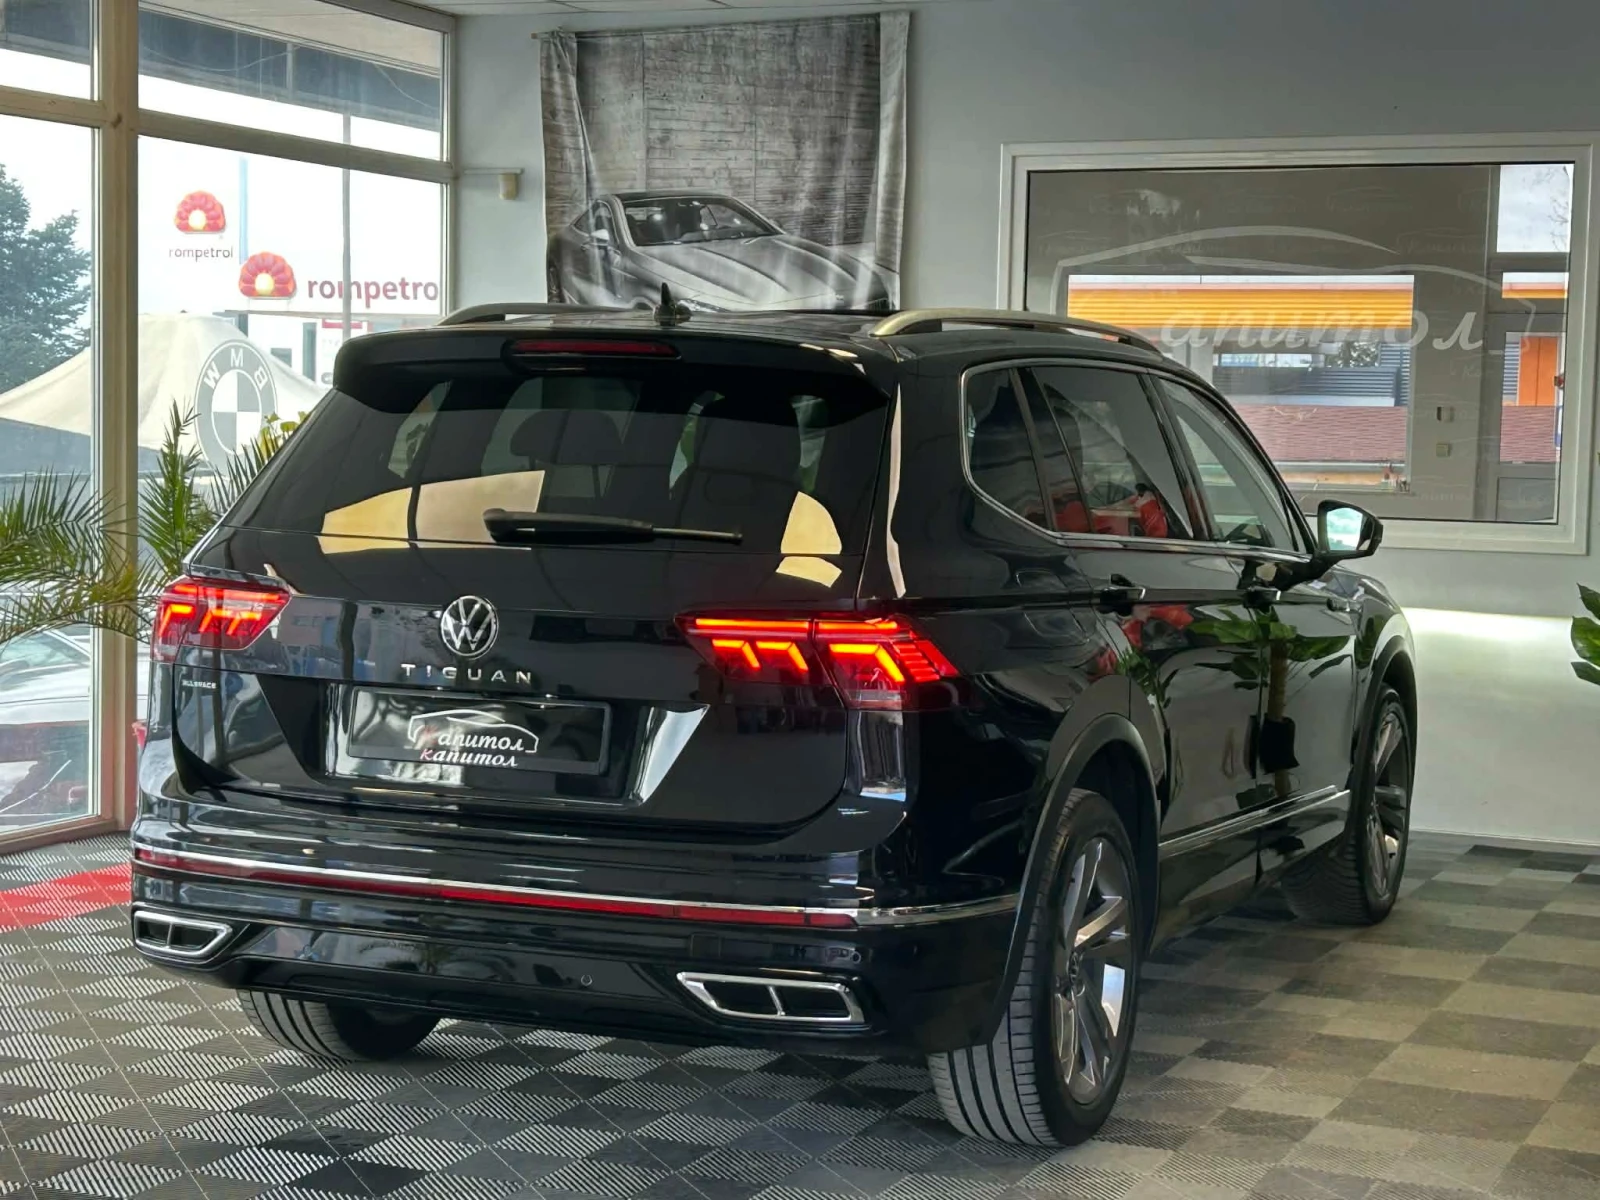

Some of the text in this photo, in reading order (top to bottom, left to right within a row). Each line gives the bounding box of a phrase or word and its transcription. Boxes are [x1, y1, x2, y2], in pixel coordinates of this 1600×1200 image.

[169, 246, 233, 262] rompetrol
[307, 277, 439, 309] rompetro
[1160, 309, 1484, 350] апитол
[401, 663, 532, 684] TIGUAN
